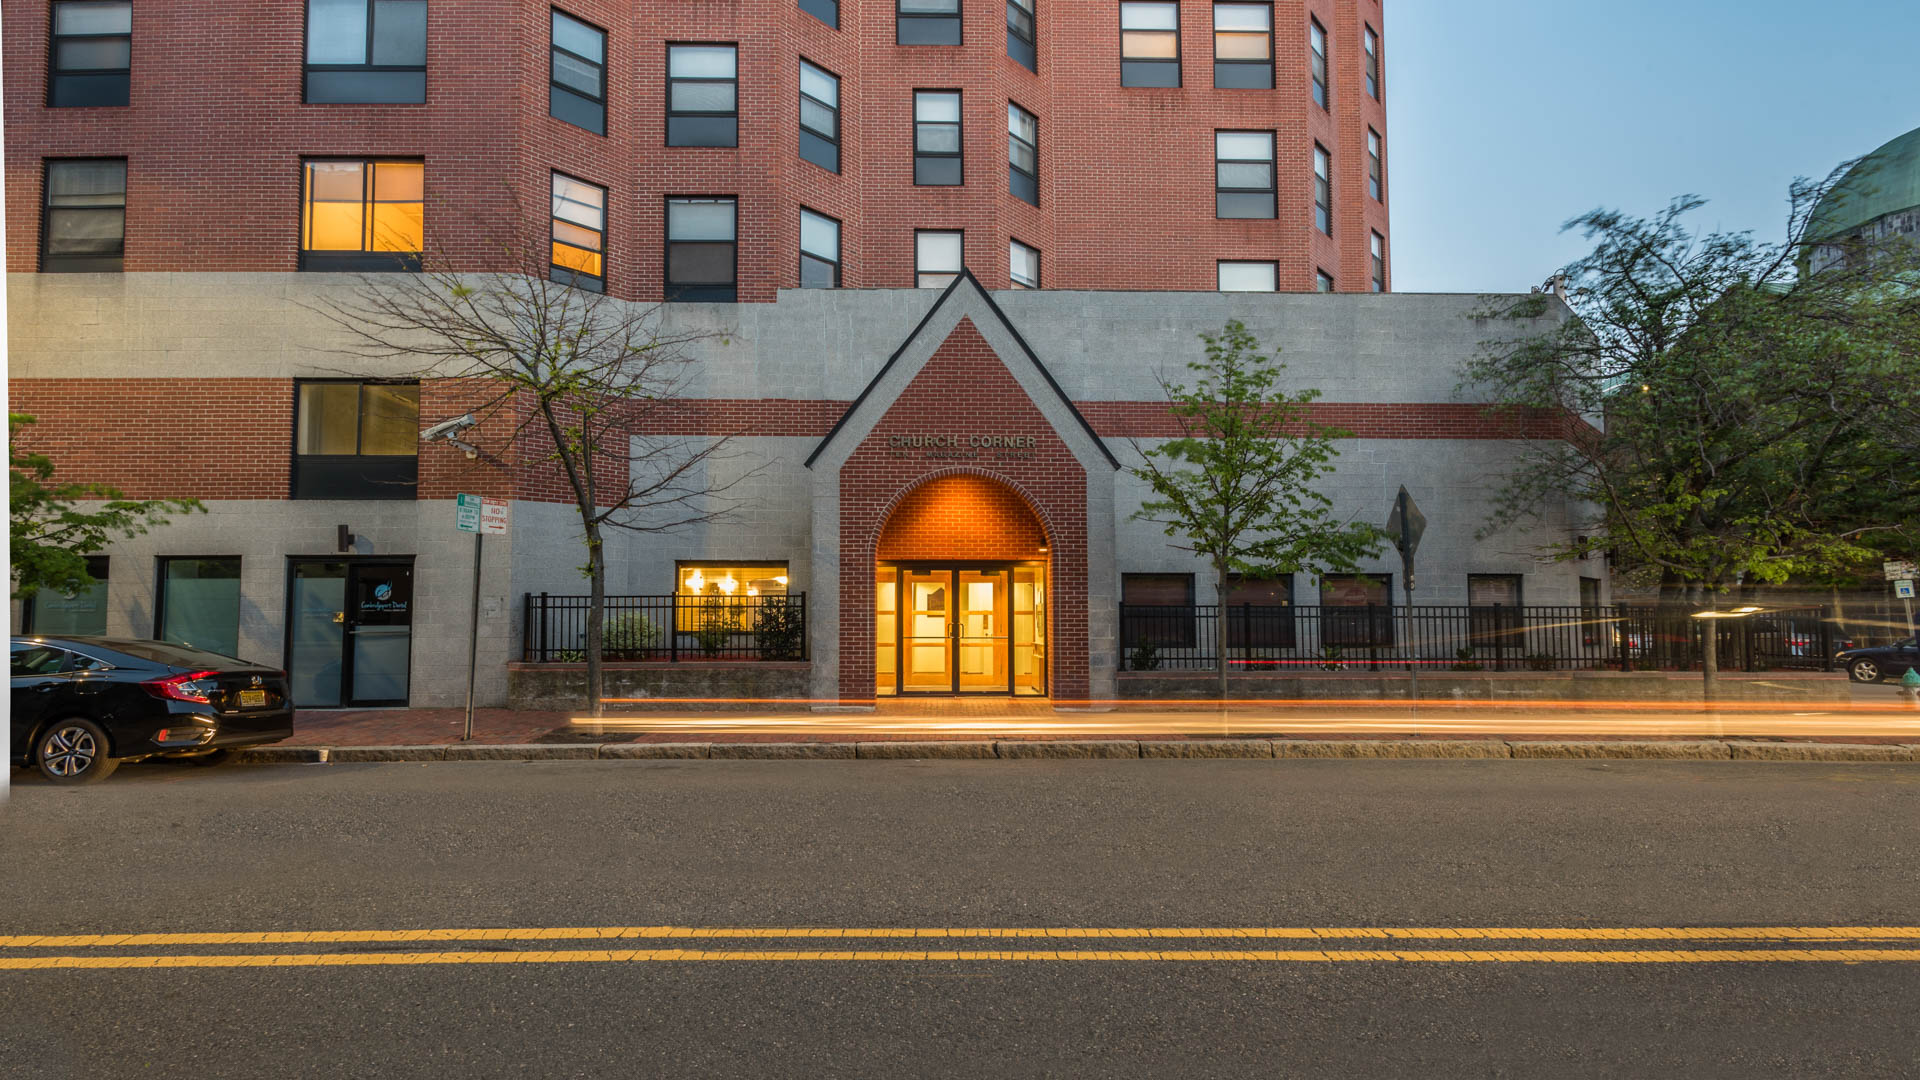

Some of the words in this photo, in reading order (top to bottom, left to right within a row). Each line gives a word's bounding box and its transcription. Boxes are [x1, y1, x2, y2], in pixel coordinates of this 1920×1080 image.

[888, 436, 958, 448] CHURCH
[969, 436, 1037, 448] CORNER
[481, 516, 507, 524] STOPPING
